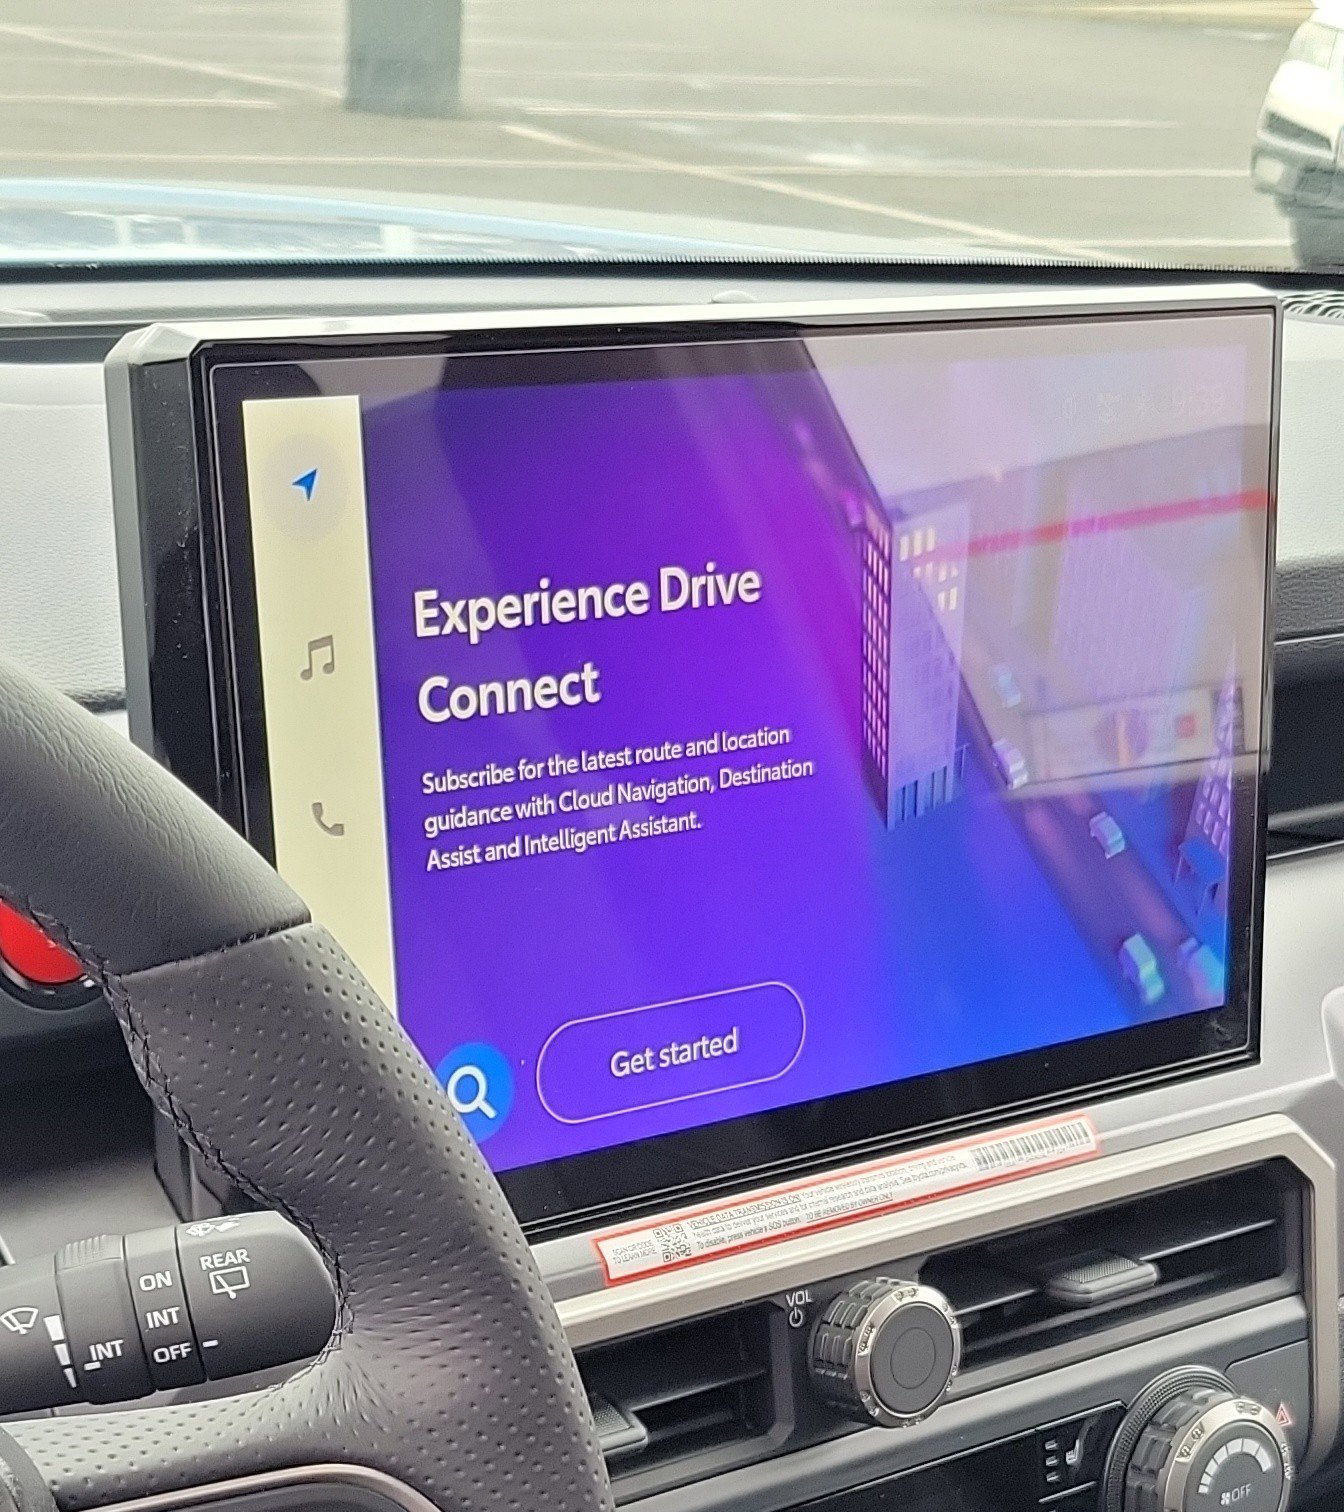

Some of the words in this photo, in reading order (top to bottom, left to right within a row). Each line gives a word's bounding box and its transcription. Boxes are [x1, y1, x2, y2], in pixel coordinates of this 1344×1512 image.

[413, 577, 650, 646] Experience
[657, 560, 763, 613] Drive
[417, 661, 602, 724] Connect
[421, 762, 516, 796] Subscribe
[517, 756, 546, 782] for
[547, 750, 580, 775] the
[580, 744, 633, 773] latest
[634, 738, 683, 765] route
[684, 732, 720, 758] and
[721, 724, 791, 754] location
[423, 801, 513, 839] guidance
[514, 795, 556, 822] with
[557, 784, 615, 815] Cloud
[616, 773, 716, 806] Navigation,
[718, 758, 814, 791] Destination
[426, 844, 482, 873] Assist
[483, 834, 521, 862] and
[523, 822, 617, 858] Intelligent
[618, 809, 703, 843] Assistant.
[610, 1047, 655, 1079] Get
[658, 1026, 739, 1068] started
[199, 1248, 251, 1270] REAR
[138, 1270, 174, 1292] ON
[785, 1290, 813, 1308] VOL
[145, 1307, 181, 1331] INT
[89, 1339, 125, 1362] INT
[152, 1342, 193, 1364] OFF
[1231, 1483, 1252, 1502] OFF
